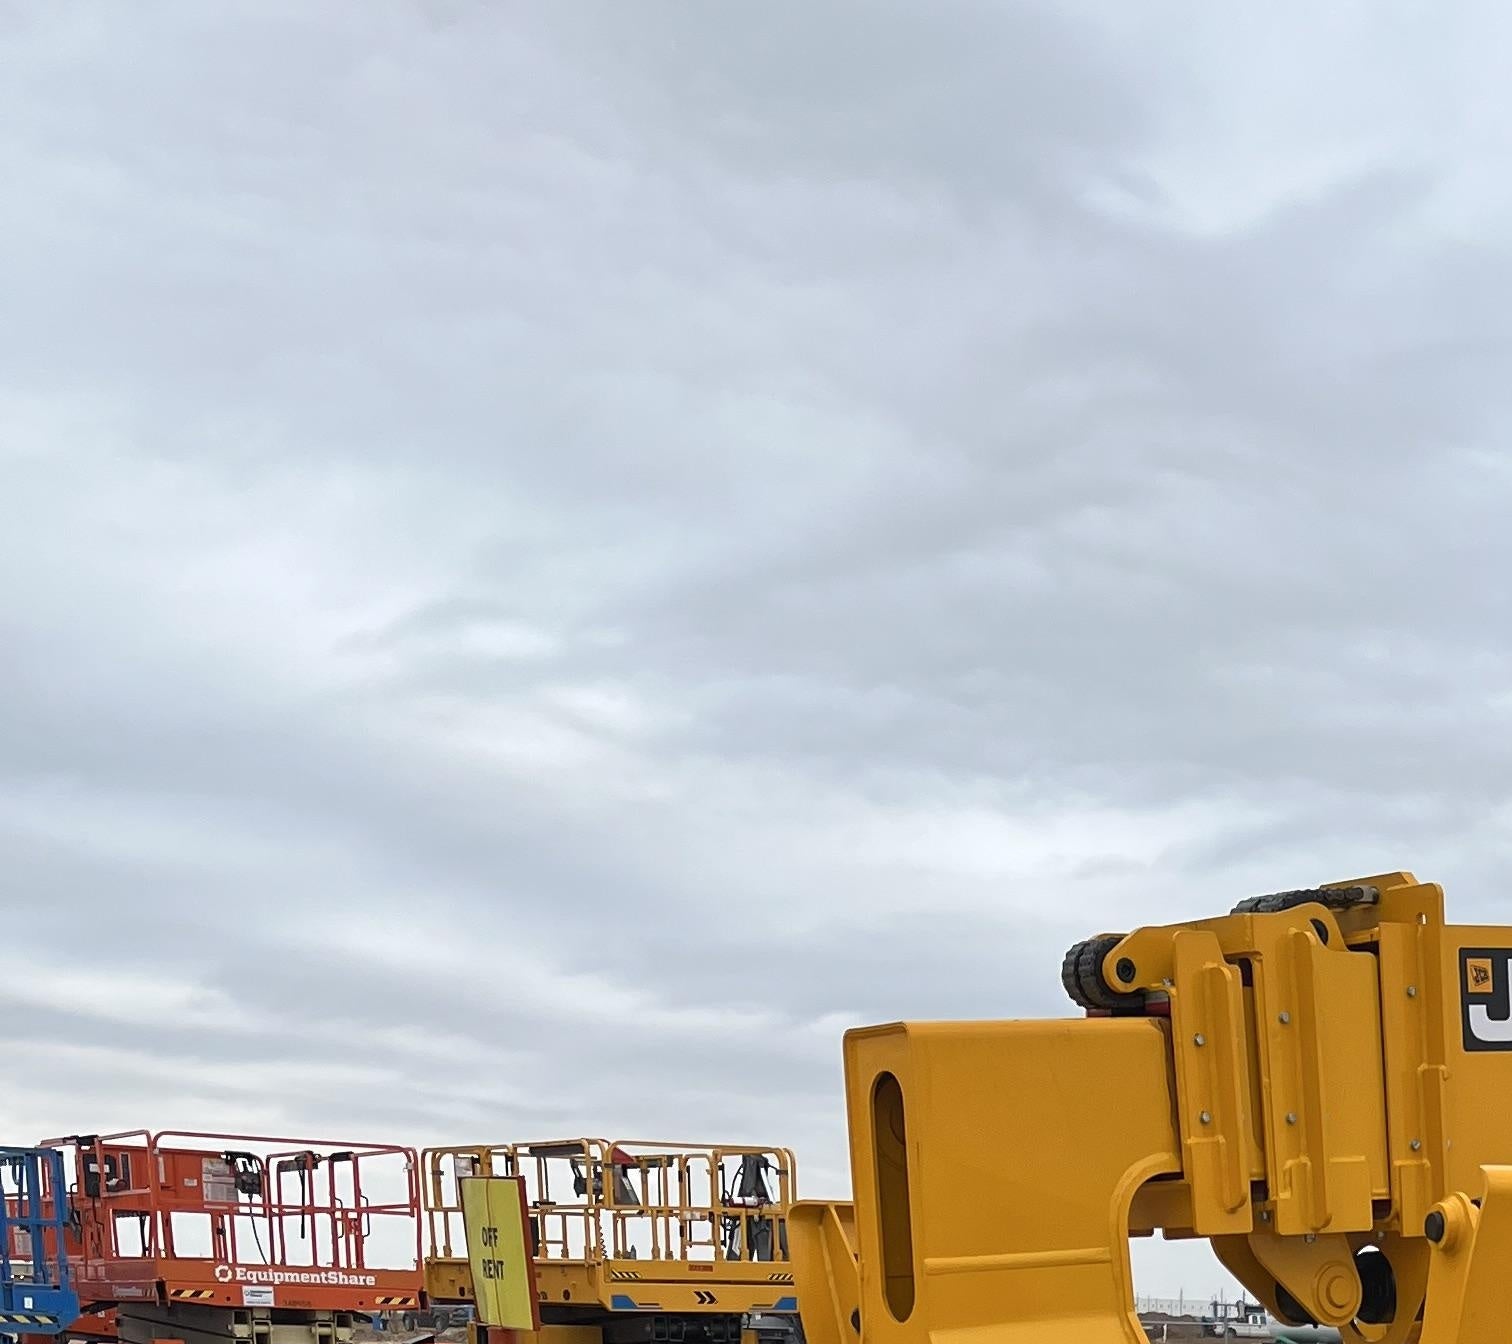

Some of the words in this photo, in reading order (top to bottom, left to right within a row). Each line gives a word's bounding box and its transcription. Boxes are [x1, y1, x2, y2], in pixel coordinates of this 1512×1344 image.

[481, 1226, 498, 1248] OFF
[234, 1266, 376, 1287] EquipmentShare
[482, 1258, 504, 1281] RENT
